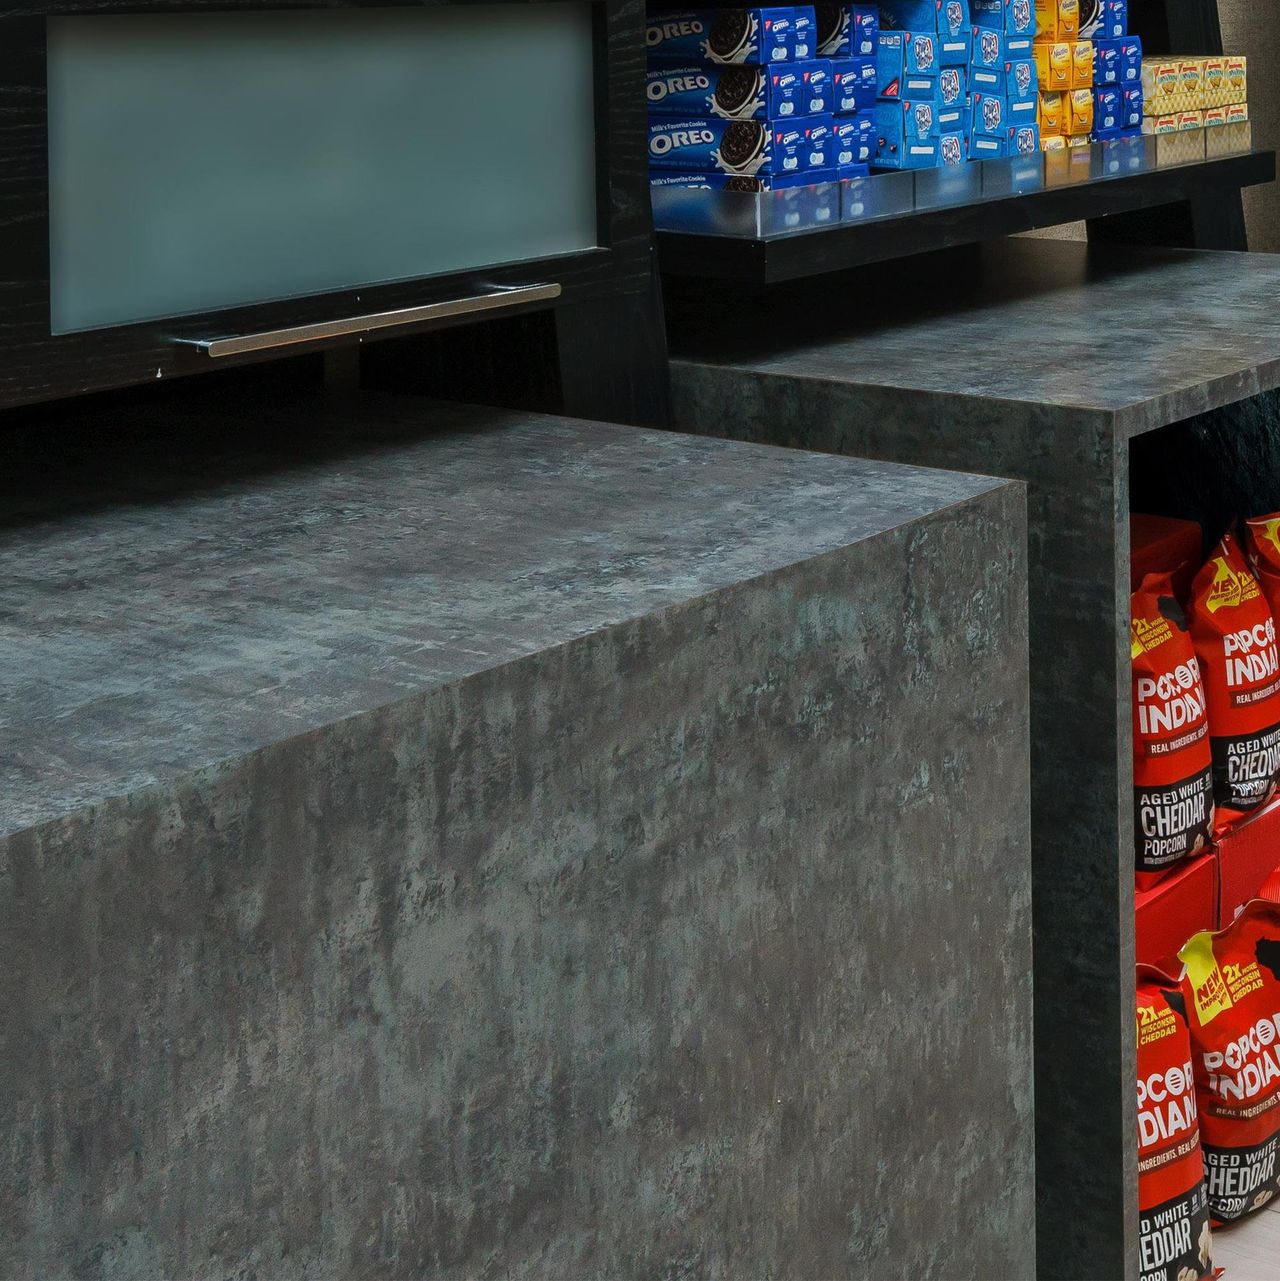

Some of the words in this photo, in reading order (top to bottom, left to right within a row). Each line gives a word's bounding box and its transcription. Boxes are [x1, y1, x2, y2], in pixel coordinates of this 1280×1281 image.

[646, 19, 704, 47] OREO
[646, 74, 710, 102] OREO
[651, 122, 667, 133] Milk's
[667, 121, 687, 131] Favorite
[688, 119, 707, 129] Cookie
[650, 129, 715, 156] OREO
[651, 177, 667, 186] Milk's
[667, 176, 688, 185] Favorite
[688, 175, 706, 184] Cookie
[1136, 620, 1150, 634] 2X
[1144, 632, 1173, 650] CHEDDAR
[1141, 793, 1205, 838] CHEDDAR
[1144, 836, 1187, 856] POPCORN
[1177, 1143, 1191, 1157] REAL
[1245, 1136, 1279, 1162] WHITE
[1153, 1200, 1190, 1227] WHITE
